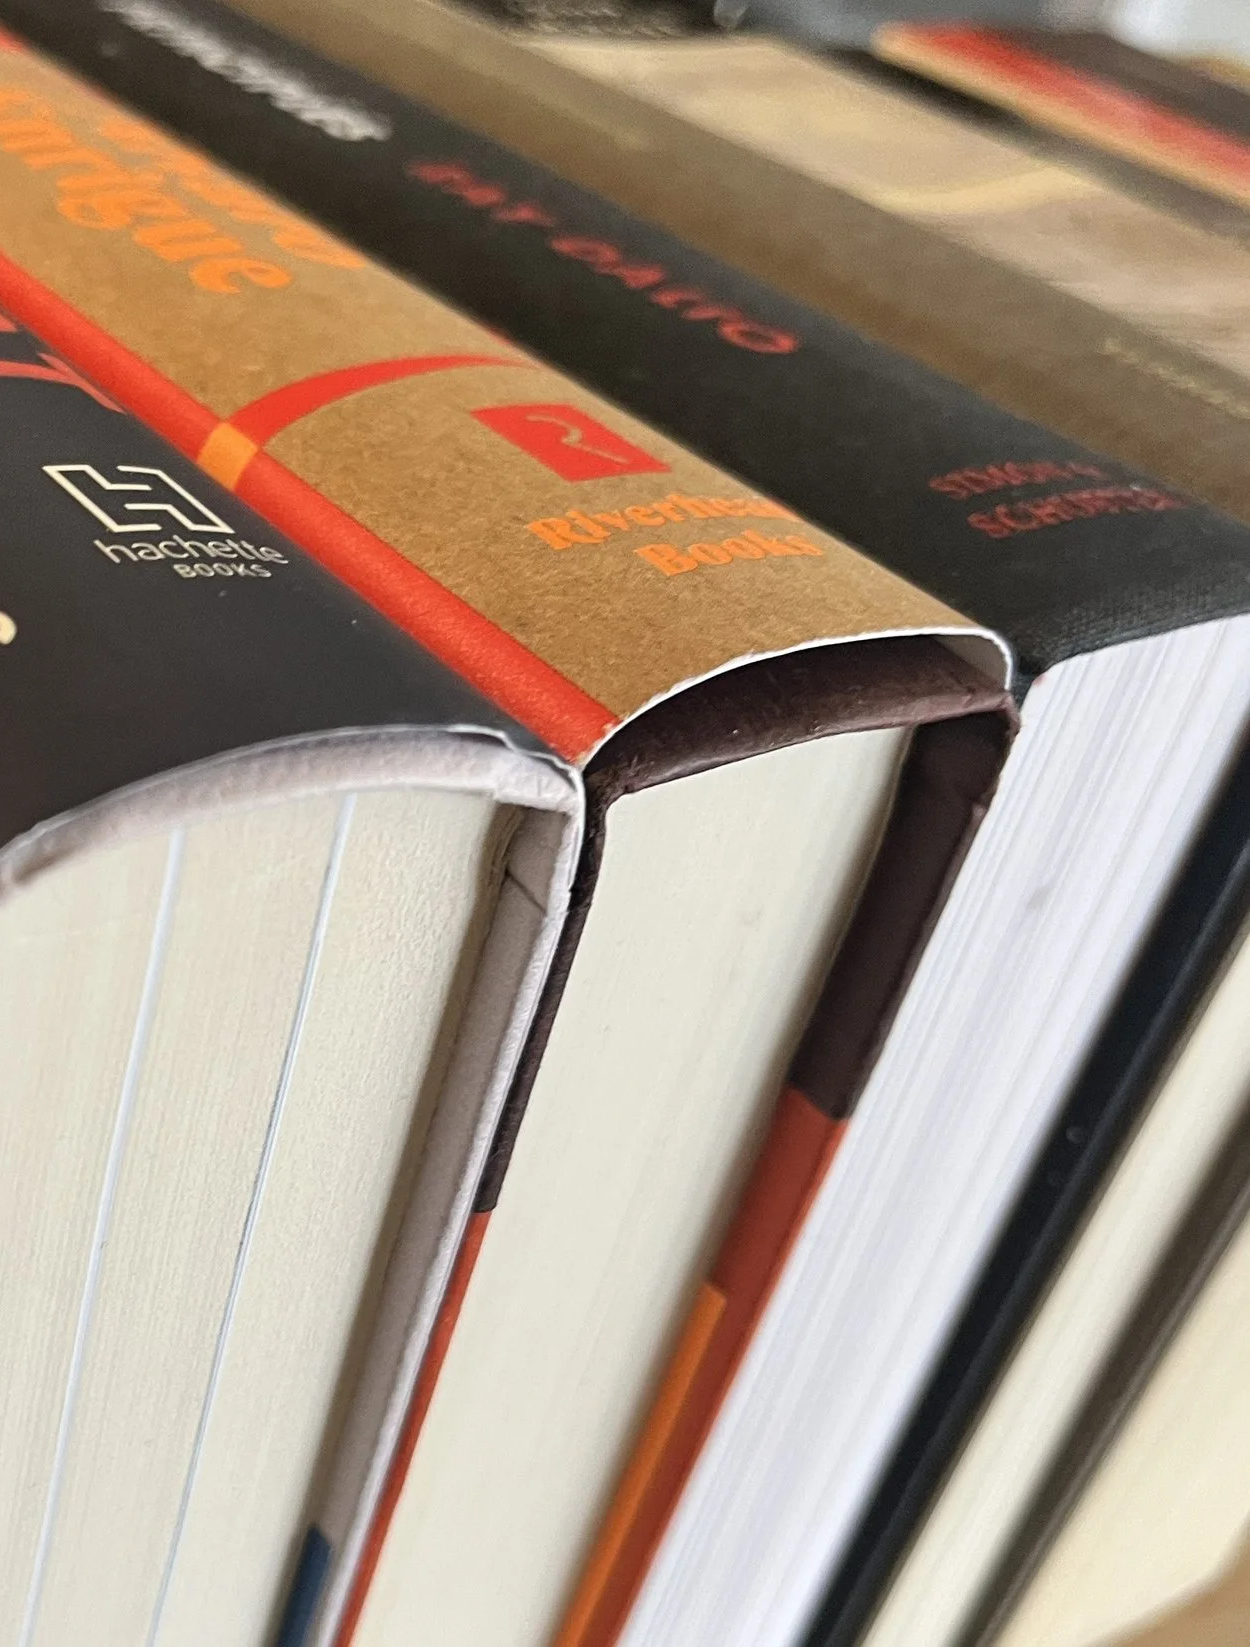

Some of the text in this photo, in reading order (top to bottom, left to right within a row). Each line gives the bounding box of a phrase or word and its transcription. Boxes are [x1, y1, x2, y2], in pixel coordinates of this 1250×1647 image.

[93, 535, 289, 563] hachette
[634, 529, 822, 576] Books
[173, 563, 272, 578] BOOKS
